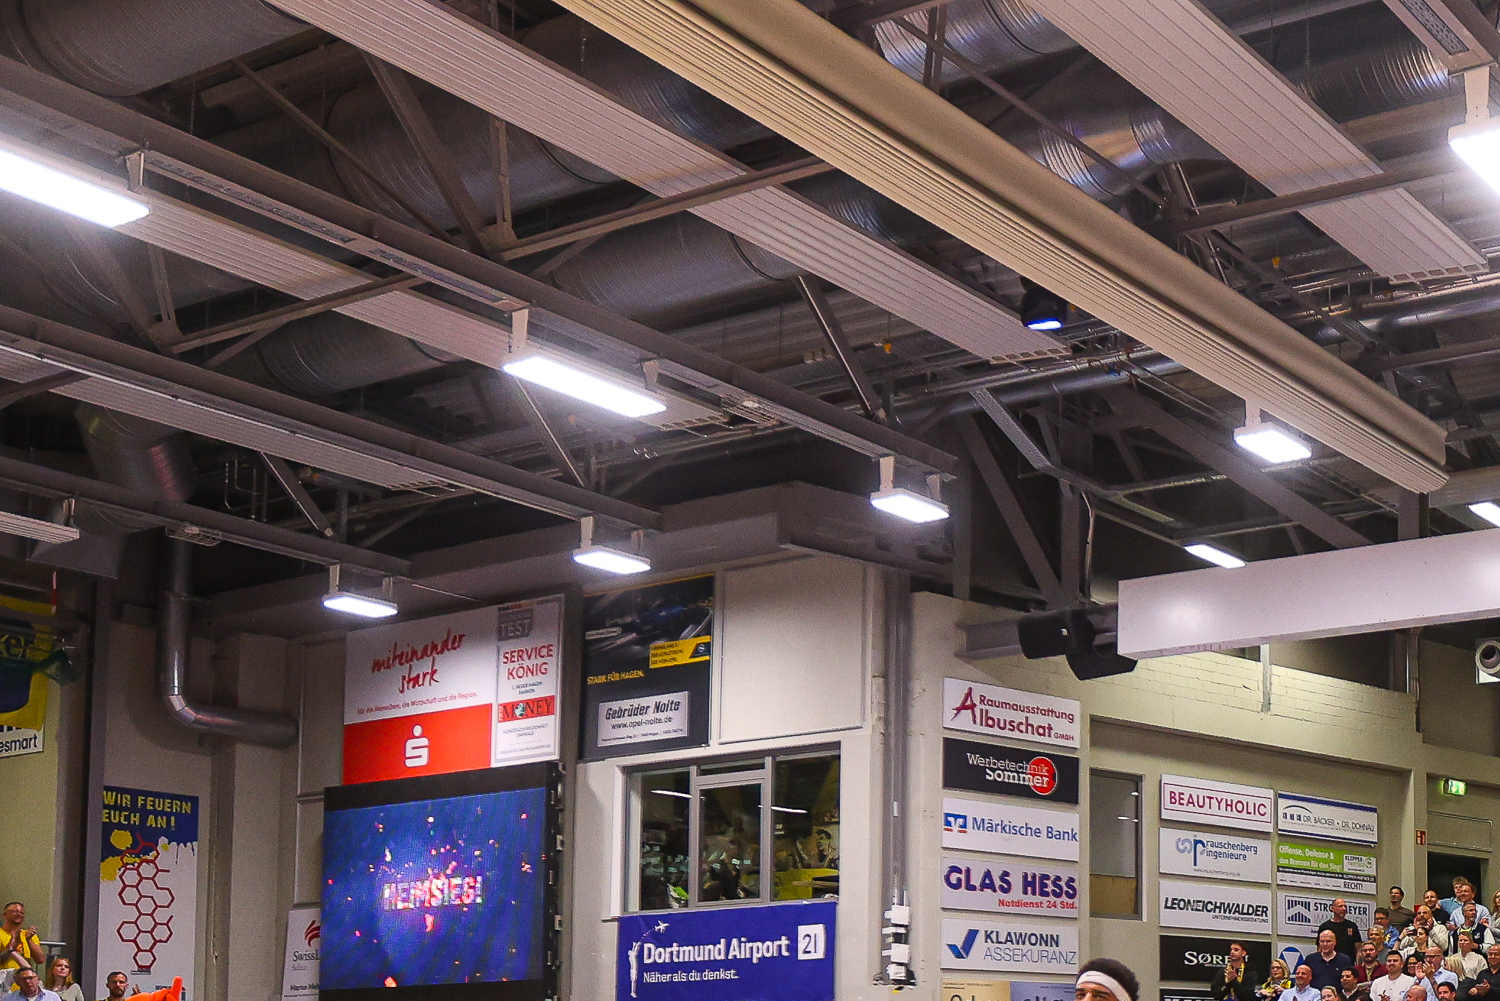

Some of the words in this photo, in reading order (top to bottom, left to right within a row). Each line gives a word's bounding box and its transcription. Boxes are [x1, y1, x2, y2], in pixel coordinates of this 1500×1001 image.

[500, 621, 531, 637] TEST
[371, 628, 466, 674] miteinander
[503, 644, 554, 664] SERVICE
[398, 656, 440, 694] stark
[507, 661, 549, 680] KÖNIG
[605, 704, 650, 720] Gebrüder
[653, 700, 681, 714] Nolte
[978, 693, 1075, 724] Raumausstattung
[611, 716, 674, 730] www.opel-nolte.de
[966, 752, 1049, 776] Werbetechnik
[985, 767, 1050, 788] Sommer
[103, 790, 132, 808] WIR
[138, 796, 192, 814] FEUERN
[1169, 790, 1267, 817] BEAUTYHOLIC
[102, 808, 140, 825] EUCH
[971, 816, 1042, 839] Märkische
[1046, 826, 1079, 844] Bank
[1206, 840, 1258, 856] rauschenberg
[1206, 849, 1248, 862] ingenieure
[944, 865, 1012, 895] GLAS
[1021, 871, 1079, 901] HESS
[998, 898, 1044, 910] Notdienst
[1046, 899, 1057, 910] 24
[1058, 900, 1078, 911] Std.
[1164, 897, 1269, 918] LEONEICHWALDER
[802, 932, 819, 955] 21
[984, 929, 1060, 948] KLAWONN
[643, 938, 727, 964] Dortmund
[728, 935, 791, 964] Airport
[983, 945, 1077, 966] ASSEKURANZ
[643, 970, 672, 983] Näher
[672, 969, 687, 982] als
[688, 968, 701, 981] du
